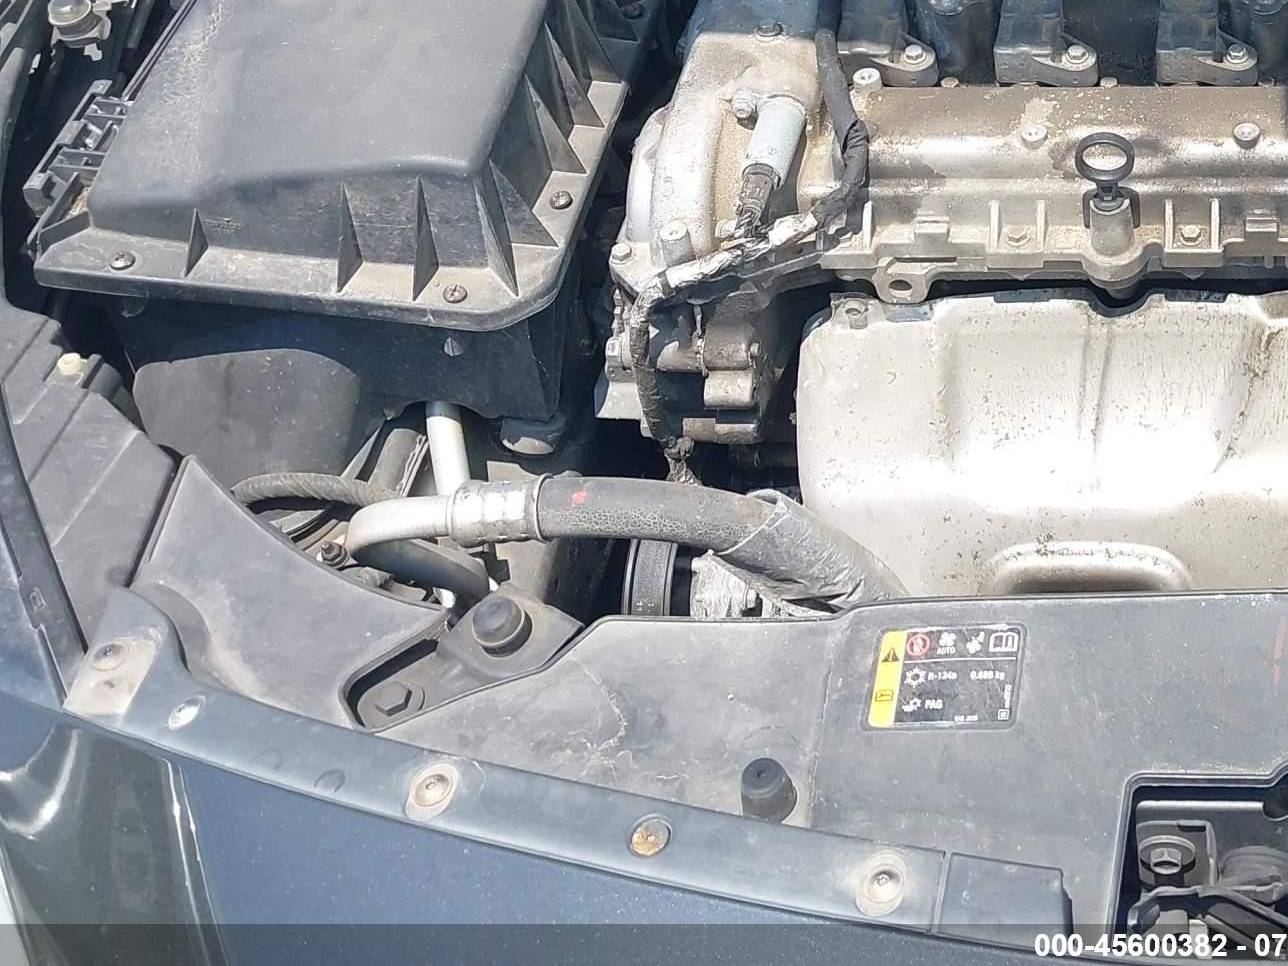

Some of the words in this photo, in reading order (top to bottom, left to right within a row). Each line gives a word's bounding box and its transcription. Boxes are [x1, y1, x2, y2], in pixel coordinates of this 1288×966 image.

[936, 646, 956, 655] AUTO
[927, 671, 958, 681] R-134a
[924, 699, 944, 709] PAG
